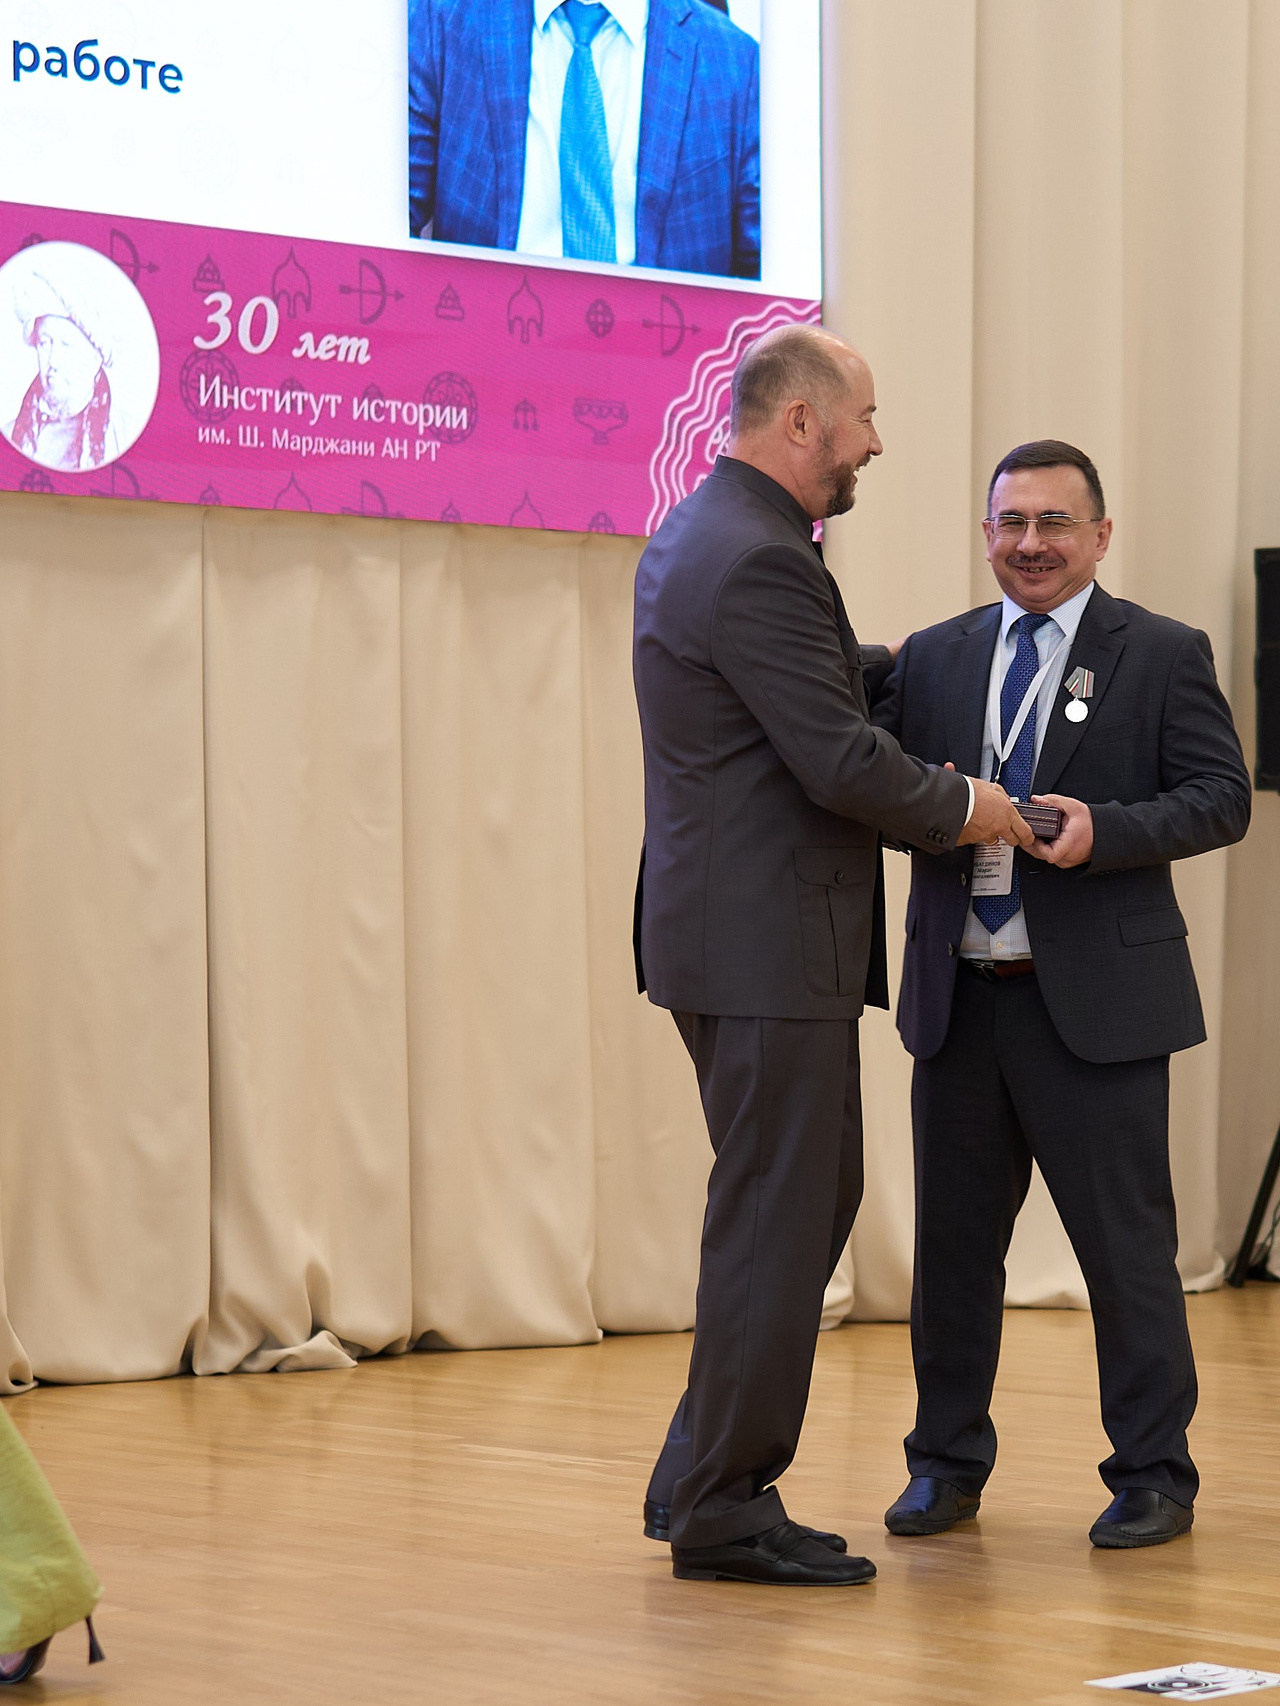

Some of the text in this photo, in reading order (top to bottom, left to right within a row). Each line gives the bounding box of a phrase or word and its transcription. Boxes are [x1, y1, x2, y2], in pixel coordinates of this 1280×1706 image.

[12, 38, 184, 94] работе
[193, 291, 371, 365] 30 лет
[199, 374, 468, 436] Институт истории
[198, 424, 441, 462] им. Ш. Марджани АН РТ
